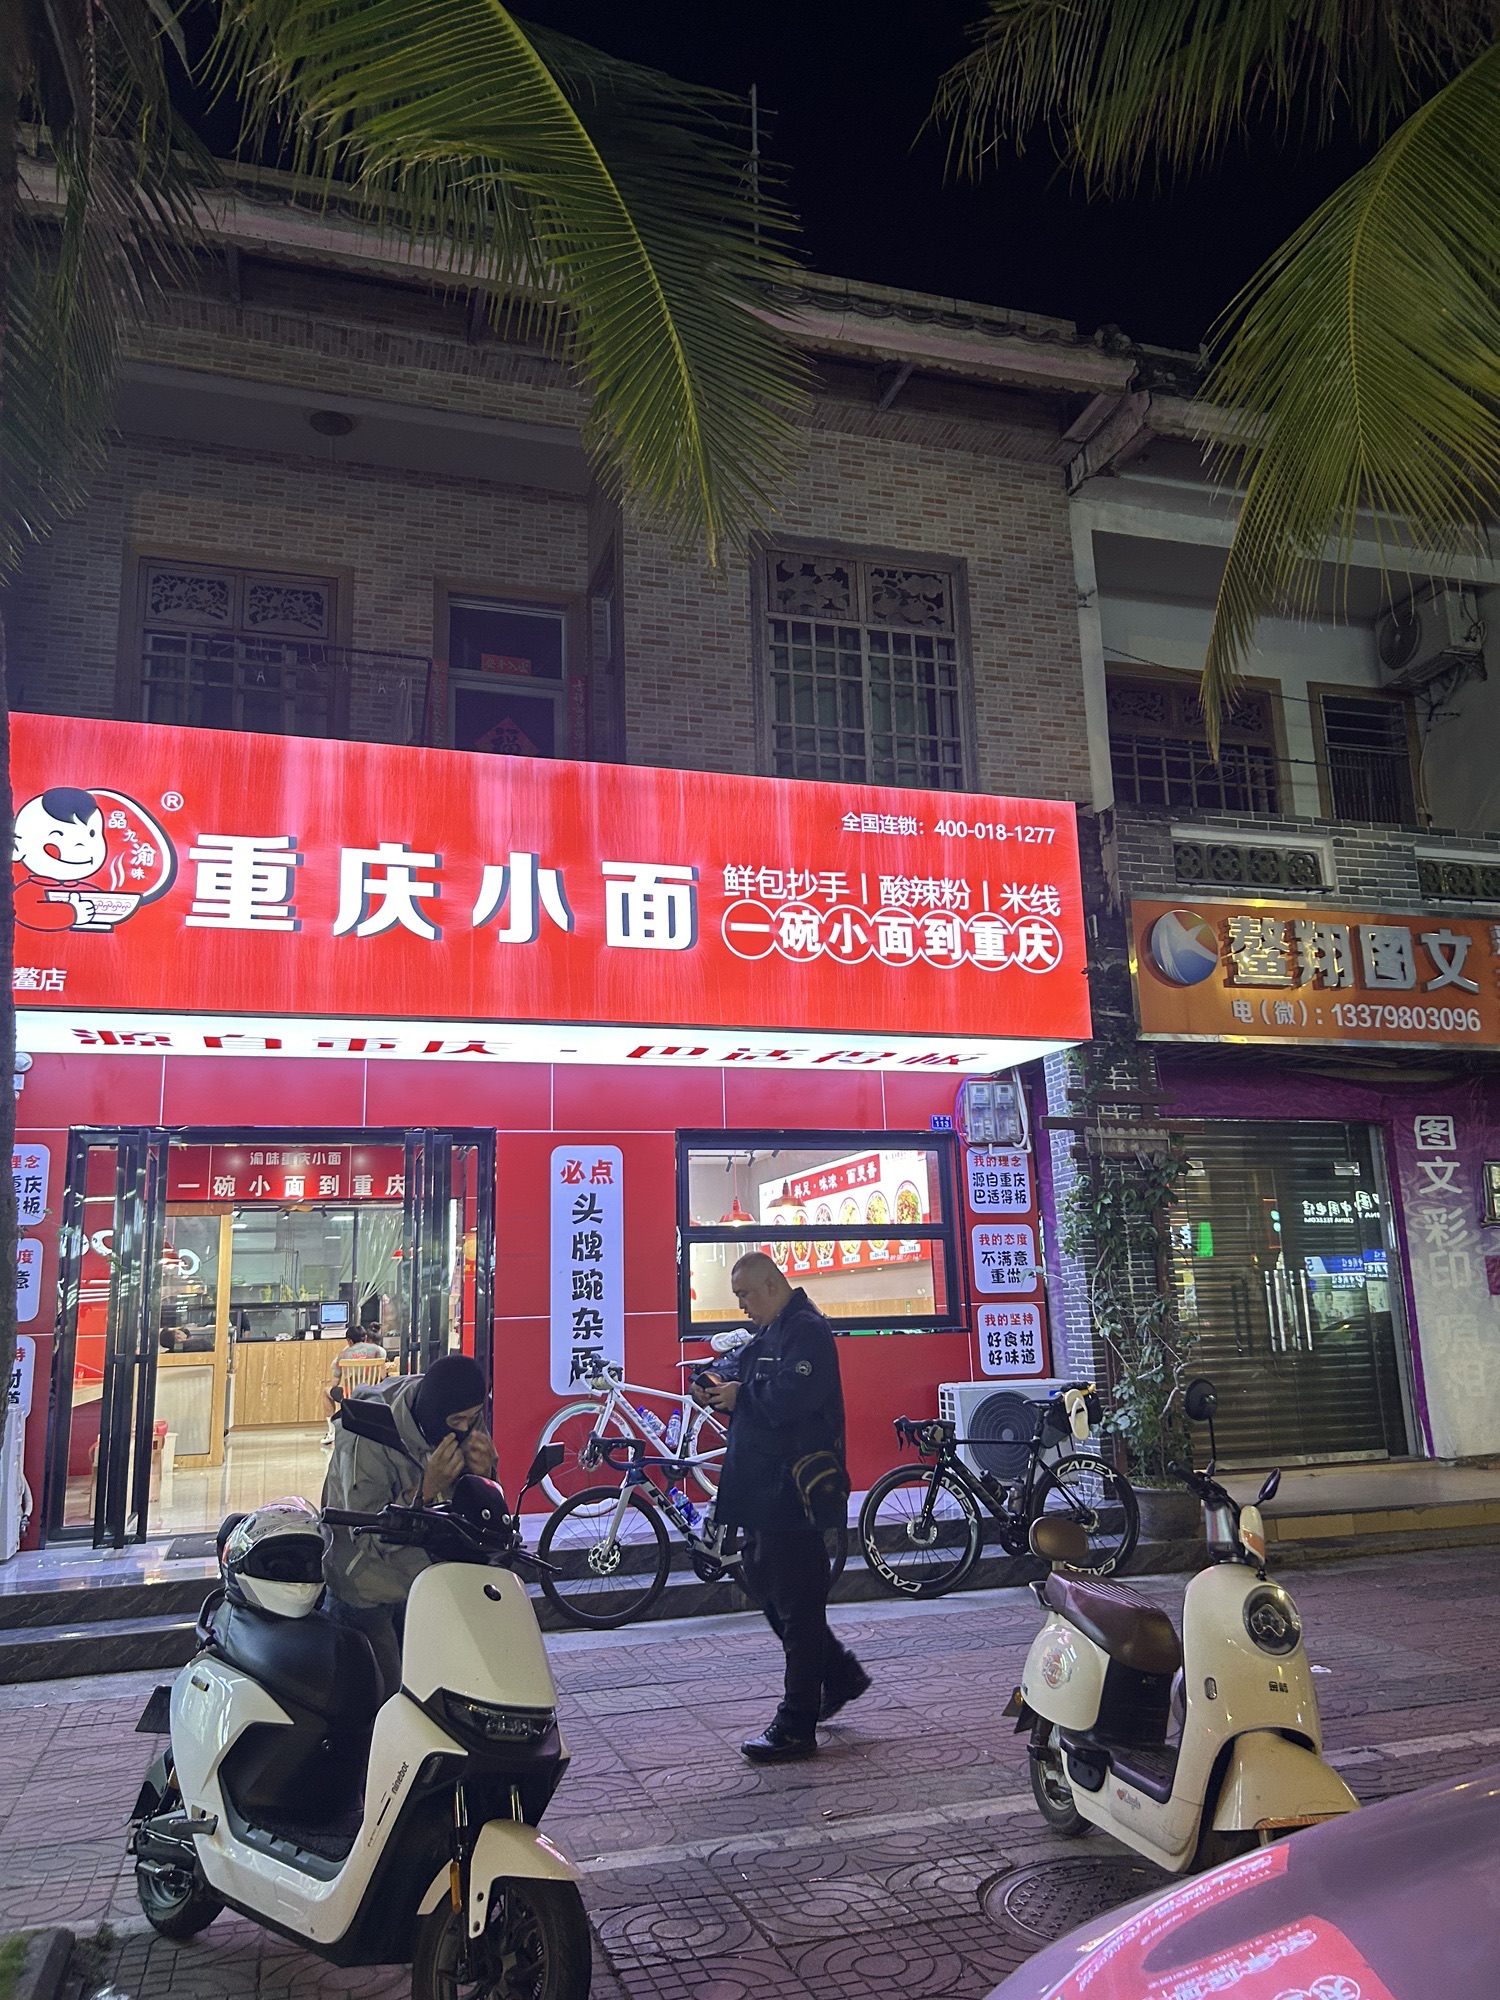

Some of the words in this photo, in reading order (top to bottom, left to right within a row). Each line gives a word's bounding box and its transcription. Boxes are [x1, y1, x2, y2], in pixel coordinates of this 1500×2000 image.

[933, 819, 1056, 845] 400-018-1277
[185, 832, 698, 951] 重庆小面
[729, 907, 1057, 966] 一碗小面到重庆
[1222, 913, 1500, 995] 鳌翔图文
[1331, 1004, 1481, 1032] 13379803096
[935, 1120, 950, 1128] 113
[249, 1151, 342, 1167] 渝味重庆小面
[973, 1155, 1022, 1168] 我的理念
[560, 1159, 615, 1185] 必点
[972, 1171, 1026, 1188] 源自重庆
[177, 1174, 406, 1198] 一碗小面到重庆
[15, 1195, 41, 1215] 板
[974, 1189, 1027, 1205] 巴适得板
[978, 1233, 1029, 1246] 我的态度
[981, 1250, 1029, 1267] 不满意
[984, 1312, 1034, 1327] 我的坚持
[987, 1330, 1034, 1348] 好食材
[988, 1348, 1036, 1366] 好味道
[1056, 1459, 1119, 1482] CADEX
[864, 1534, 923, 1594] CADEX
[391, 1760, 410, 1795] ninebot
